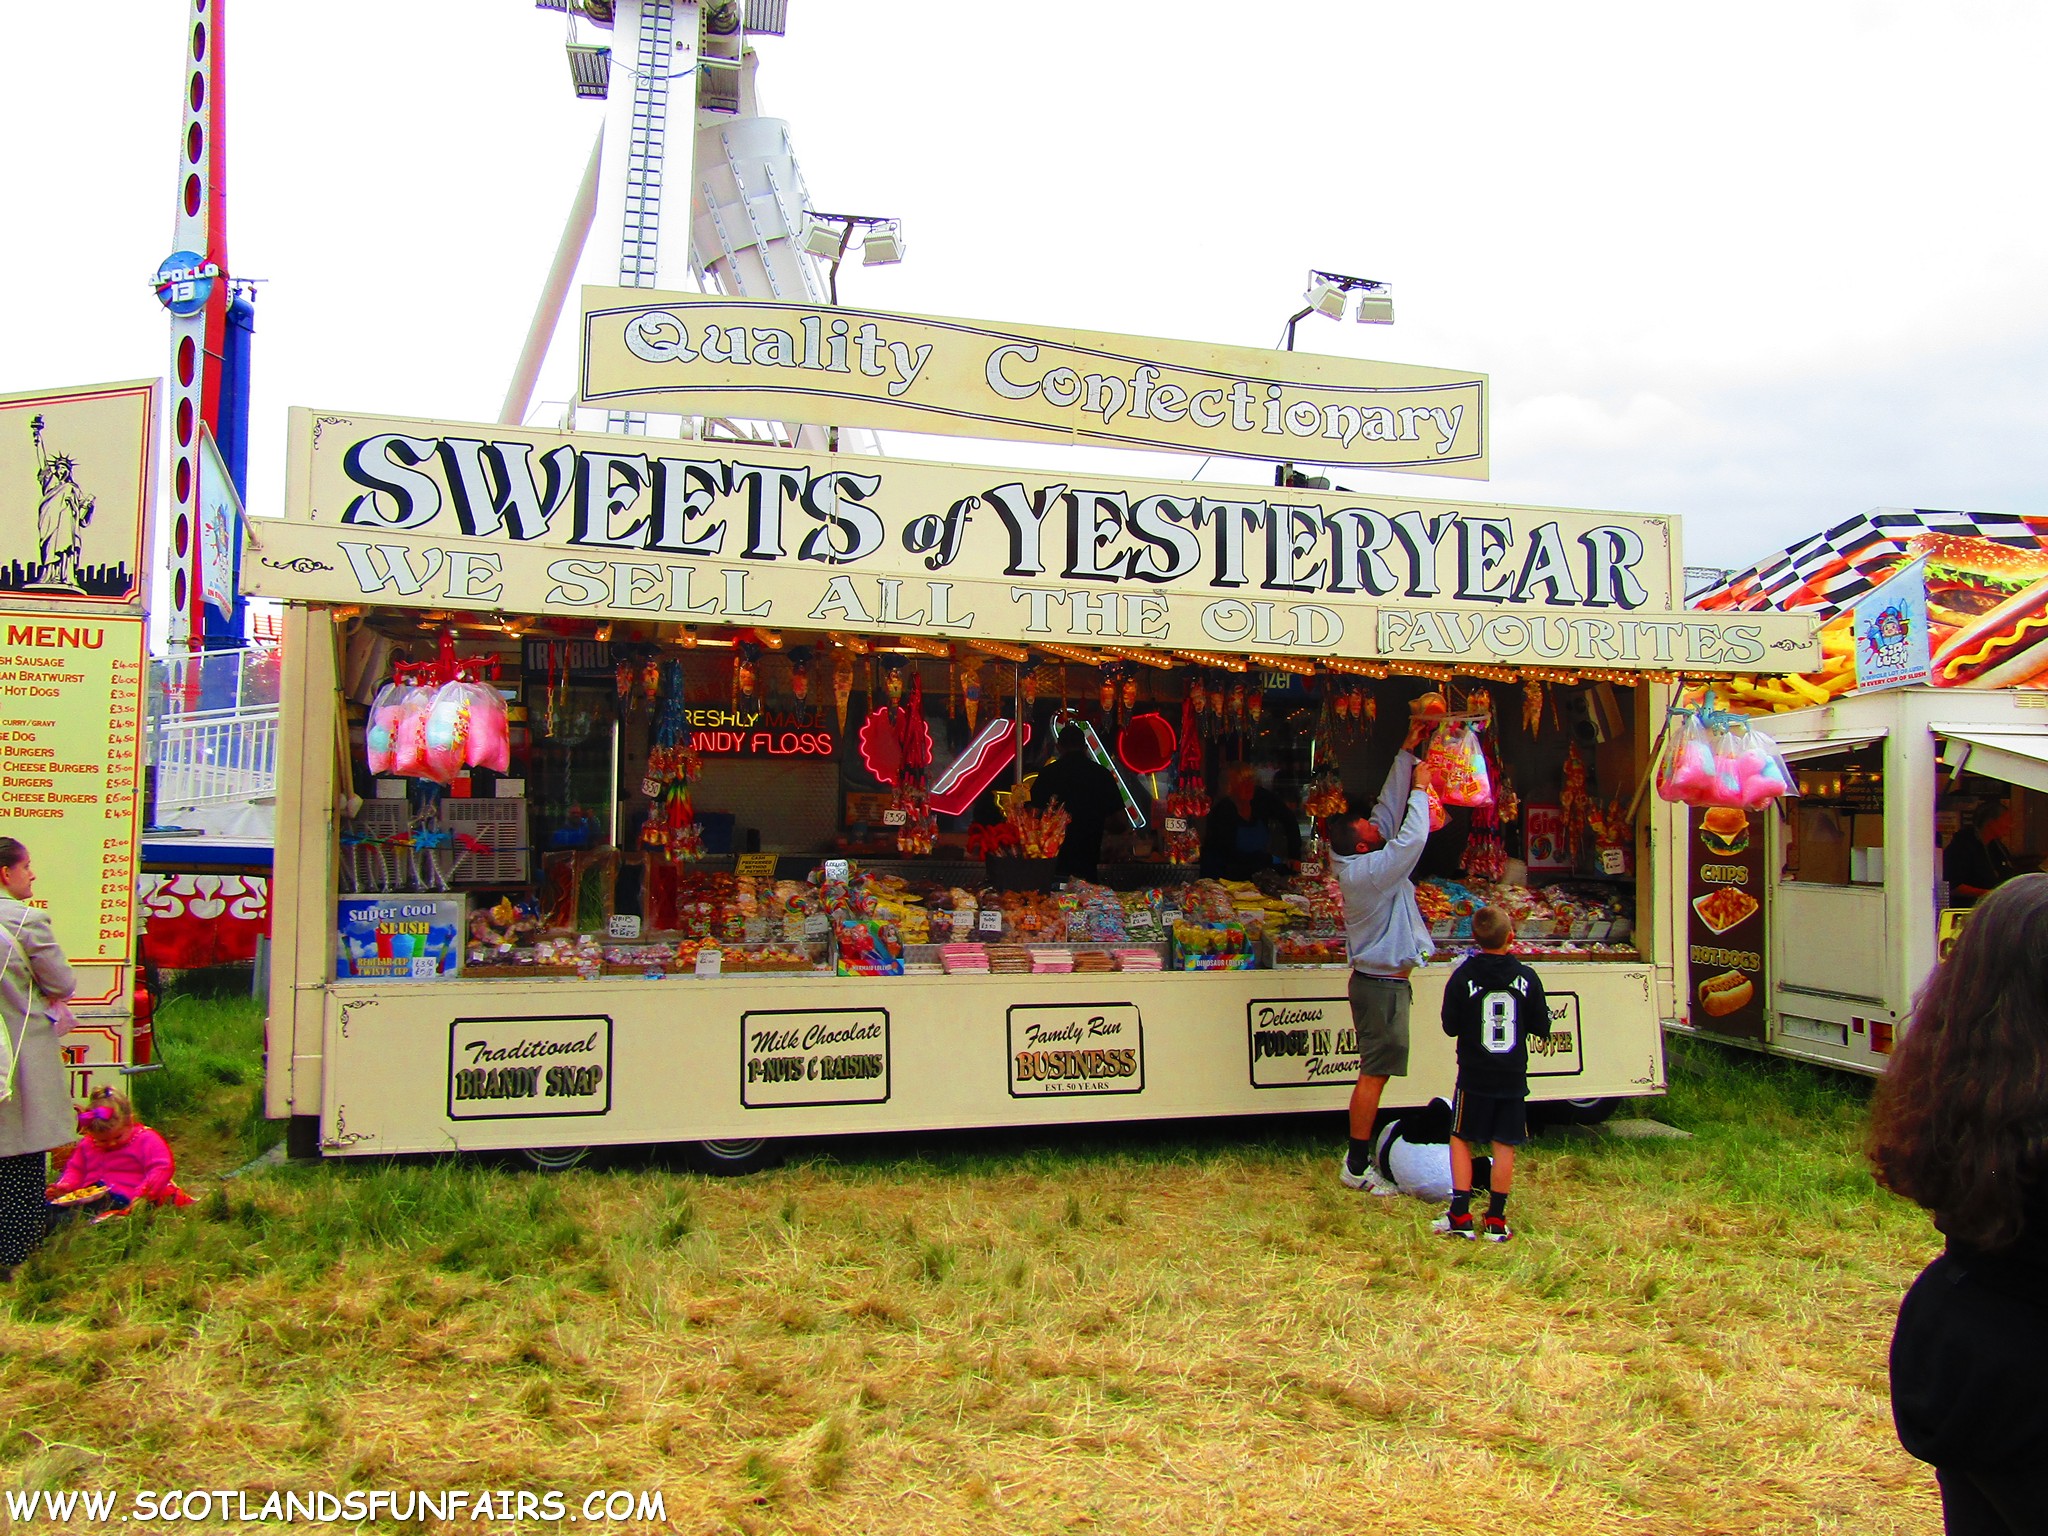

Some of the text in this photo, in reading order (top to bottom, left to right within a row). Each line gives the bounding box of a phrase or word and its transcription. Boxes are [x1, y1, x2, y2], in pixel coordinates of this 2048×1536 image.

[148, 263, 219, 286] APOLLO
[171, 281, 195, 302] 13
[623, 310, 1464, 455] Quality Confectionary
[341, 433, 1648, 610] SWEETS of YESTERYEAR
[337, 541, 1766, 664] WE SELL ALL THE OLD FAVOURITES
[6, 625, 104, 649] MENU
[15, 655, 65, 667] SAUSAGE
[571, 641, 609, 669] BRU
[19, 671, 85, 683] BRATWURST
[5, 685, 27, 696] HOT
[30, 686, 60, 697] DOGS
[684, 709, 760, 727] RESHLY
[12, 731, 36, 741] DOG
[752, 732, 832, 755] FLOSS
[4, 746, 55, 757] BURGERS
[3, 761, 46, 772] CHEESE
[49, 762, 99, 773] BURGERS
[2, 776, 53, 787] BURGERS
[1, 791, 45, 803] CHEESE
[47, 792, 98, 803] BURGERS
[13, 807, 64, 818] BURGERS
[1700, 864, 1748, 884] CHIPS
[349, 903, 437, 922] Super Cool
[380, 921, 430, 935] SLUSH
[1196, 959, 1225, 967] DINOSAUR
[1259, 1007, 1323, 1028] Delicious
[1481, 990, 1517, 1054] 8
[751, 1022, 882, 1053] Milk Chocolate
[1025, 1016, 1122, 1049] Family Run
[465, 1031, 598, 1064] Traditional
[1253, 1030, 1310, 1063] FUDGE
[1312, 1029, 1332, 1056] IN
[747, 1056, 805, 1083] P-NUTS
[820, 1054, 884, 1080] RAISINS
[1015, 1049, 1137, 1081] BUSINESS
[455, 1064, 603, 1100] BRANDY SNAP
[1045, 1082, 1109, 1092] EST. 50 YEARS
